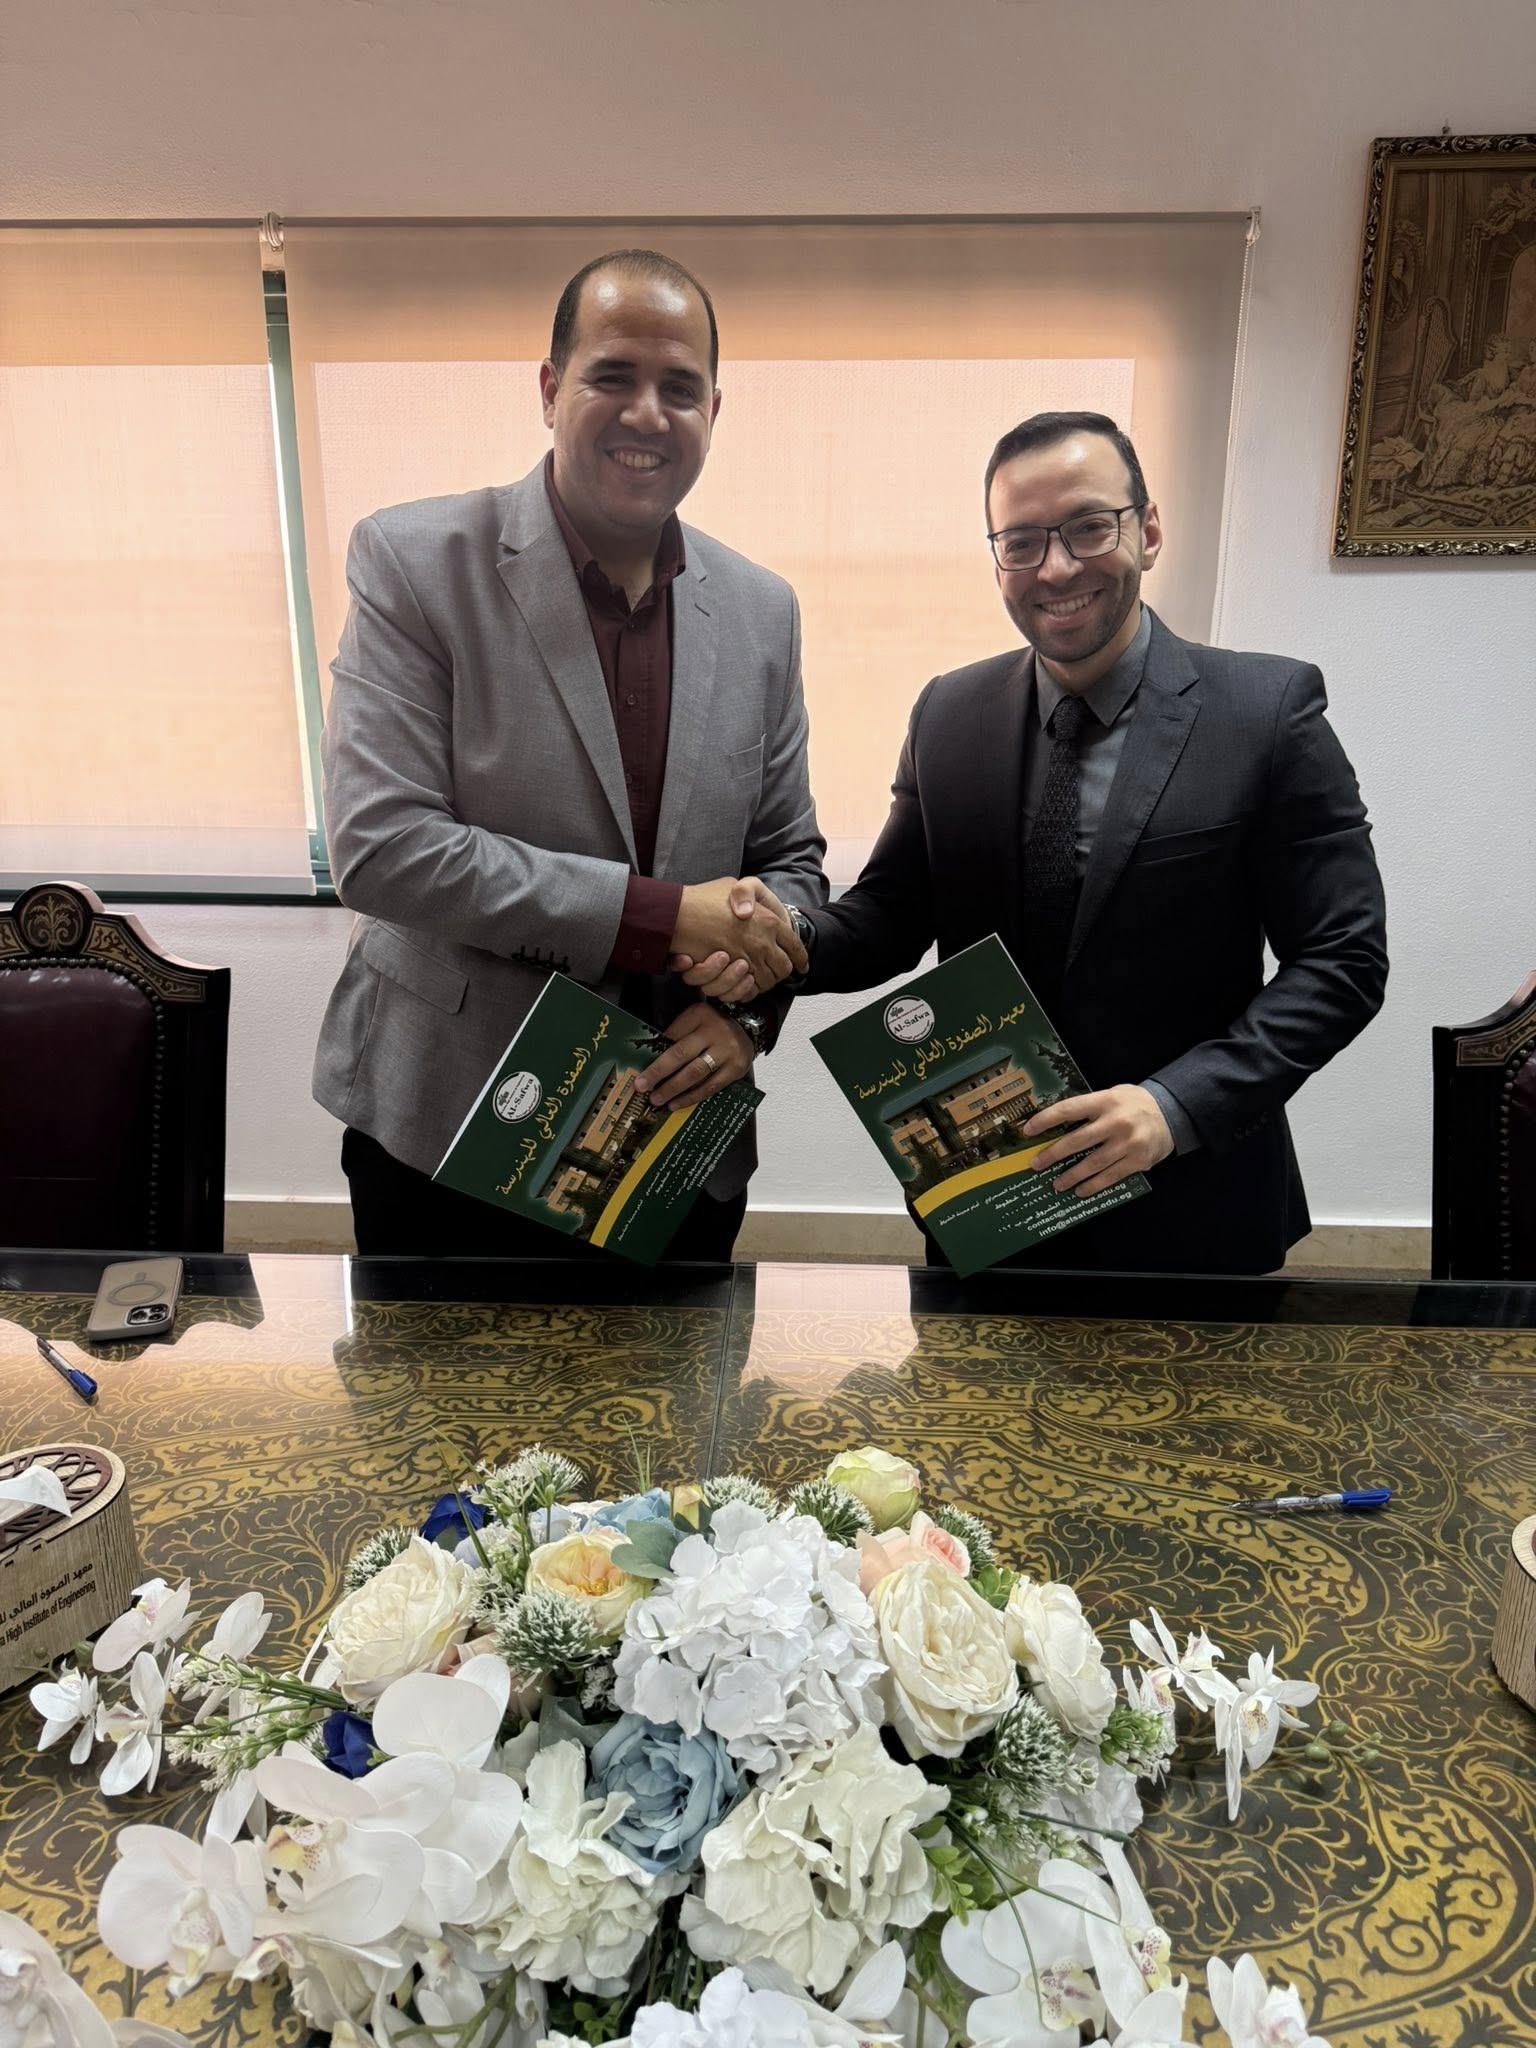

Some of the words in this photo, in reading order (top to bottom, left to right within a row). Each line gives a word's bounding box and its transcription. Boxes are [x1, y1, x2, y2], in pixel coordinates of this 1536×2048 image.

[592, 1014, 609, 1050] معهد
[893, 1011, 929, 1033] Al-Safwa
[945, 1014, 992, 1050] الصفوة
[997, 1003, 1024, 1030] معهد
[556, 1047, 590, 1095] الصفوة
[854, 1059, 906, 1098] للهندسة
[913, 1039, 945, 1080] العالي
[507, 1078, 533, 1117] Al-Safwa
[535, 1096, 562, 1139] العالي
[495, 1138, 536, 1194] للهندسة
[995, 1195, 1018, 1209] خطوط
[1027, 1183, 1125, 1230] contact@alsafwa.edu.eg
[1035, 1201, 1060, 1218] الشروق
[1039, 1191, 1131, 1235] info@alsafwa.edu.eg
[72, 1563, 92, 1580] معهد
[6, 1622, 23, 1642] High
[22, 1609, 49, 1631] Institute
[50, 1599, 59, 1614] of
[58, 1580, 96, 1609] Engineering
